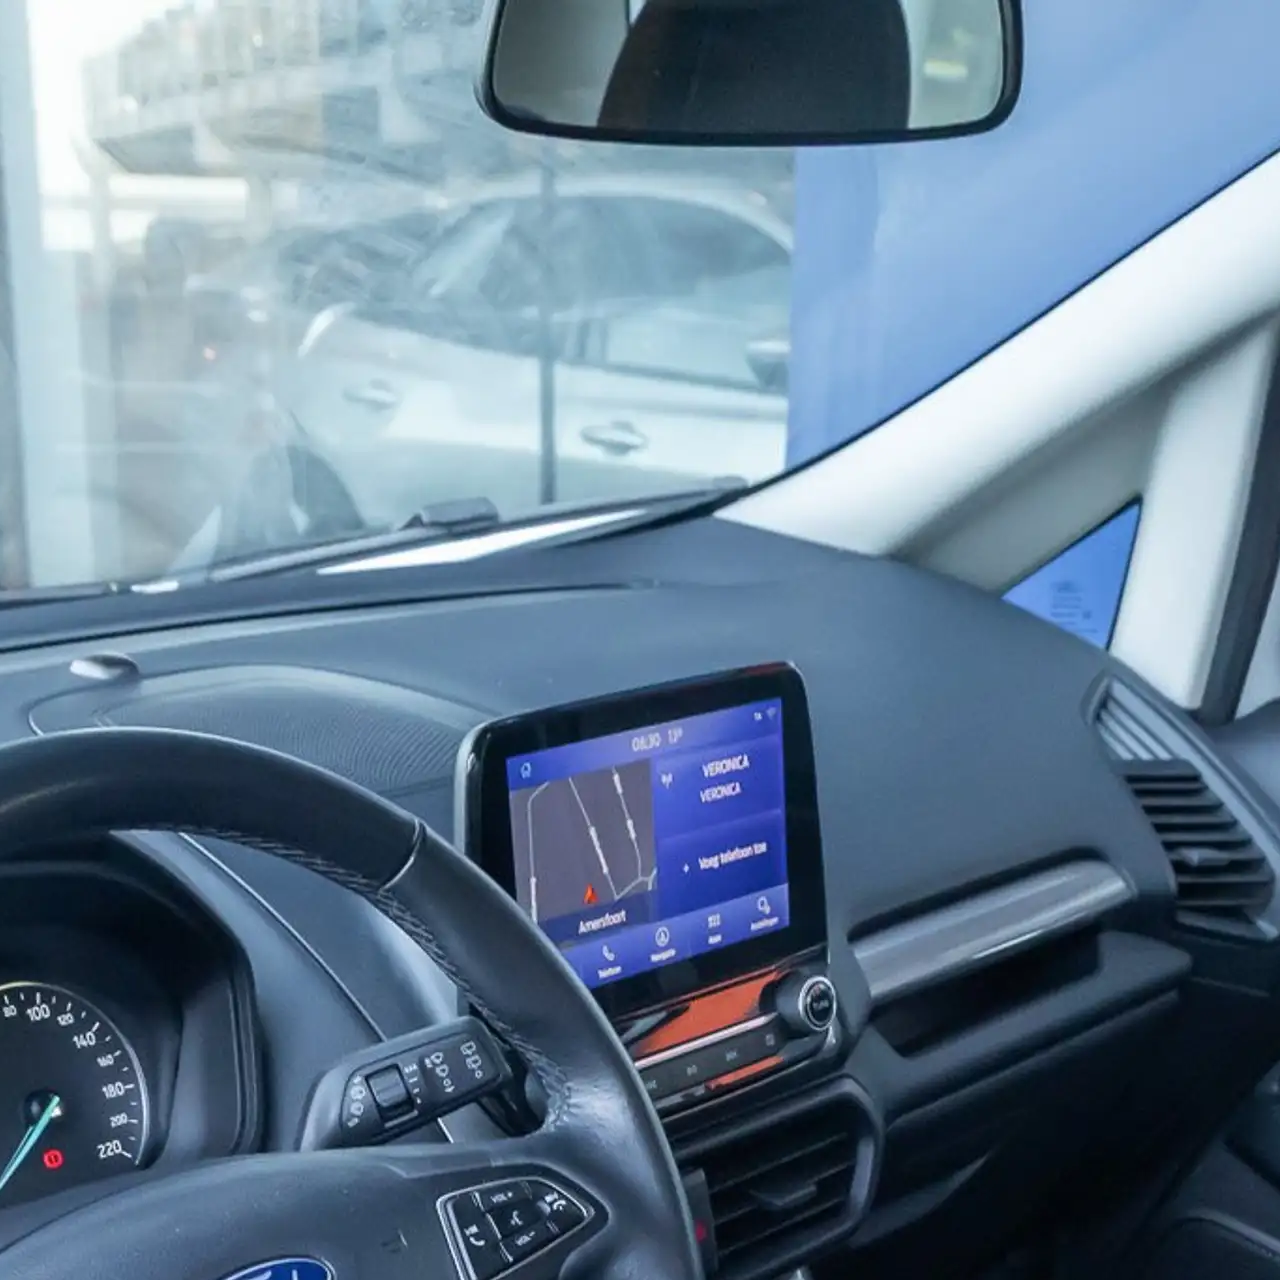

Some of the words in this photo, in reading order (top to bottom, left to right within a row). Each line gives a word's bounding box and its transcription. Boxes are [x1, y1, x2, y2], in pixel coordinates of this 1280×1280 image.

[702, 753, 750, 779] VERONICA
[699, 781, 742, 804] VERONICA
[578, 909, 627, 936] Amersfoort
[2, 1004, 17, 1018] 80
[26, 1004, 51, 1022] 100
[56, 1013, 74, 1027] 120
[72, 1031, 96, 1050] 140
[96, 1054, 115, 1068] 160
[101, 1082, 125, 1099] 180
[109, 1112, 128, 1128] 200
[96, 1139, 123, 1160] 220
